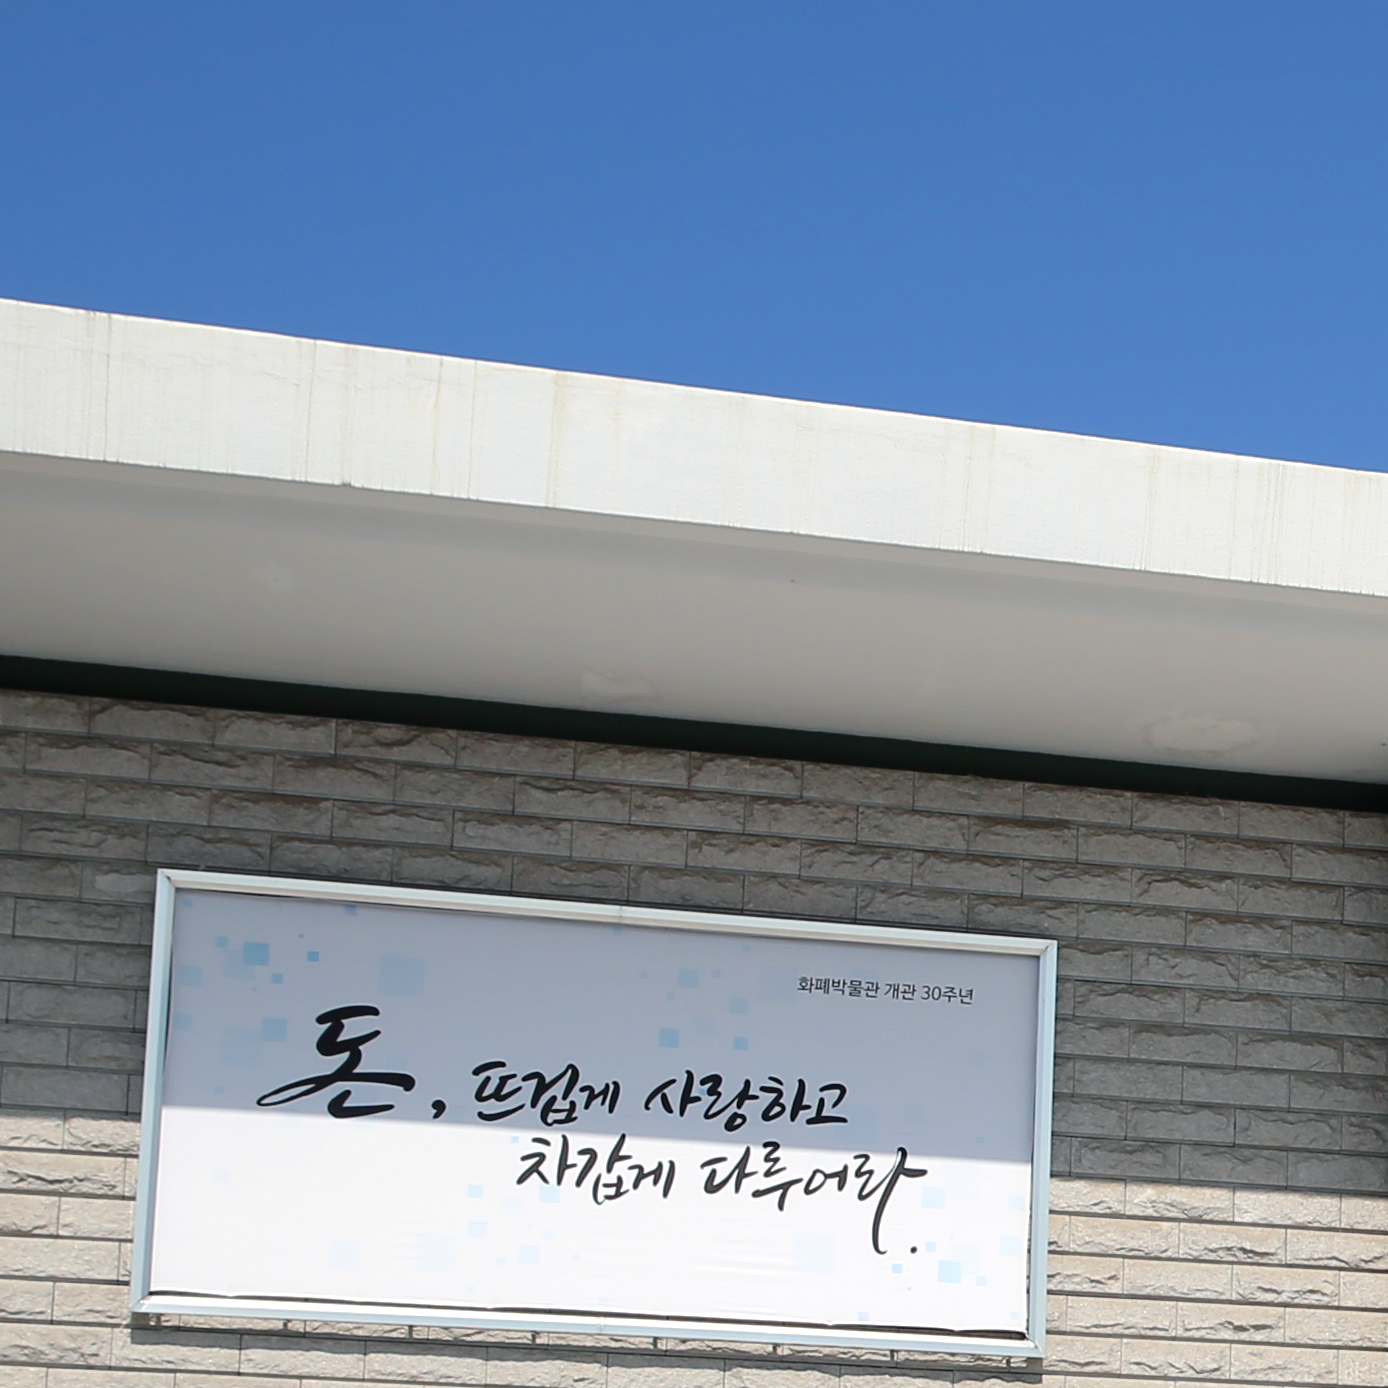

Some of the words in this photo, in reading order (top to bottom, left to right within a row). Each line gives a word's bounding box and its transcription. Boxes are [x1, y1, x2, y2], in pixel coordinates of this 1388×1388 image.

[797, 976, 880, 998] 화폐박물관
[884, 982, 917, 1001] 개관
[920, 985, 974, 1006] 30주년
[255, 1004, 447, 1119] 돈,
[471, 1060, 621, 1127] 뜨겁게
[643, 1069, 849, 1132] 사랑하고
[515, 1133, 676, 1206] 차갑게
[699, 1141, 928, 1256] 다루어라.
